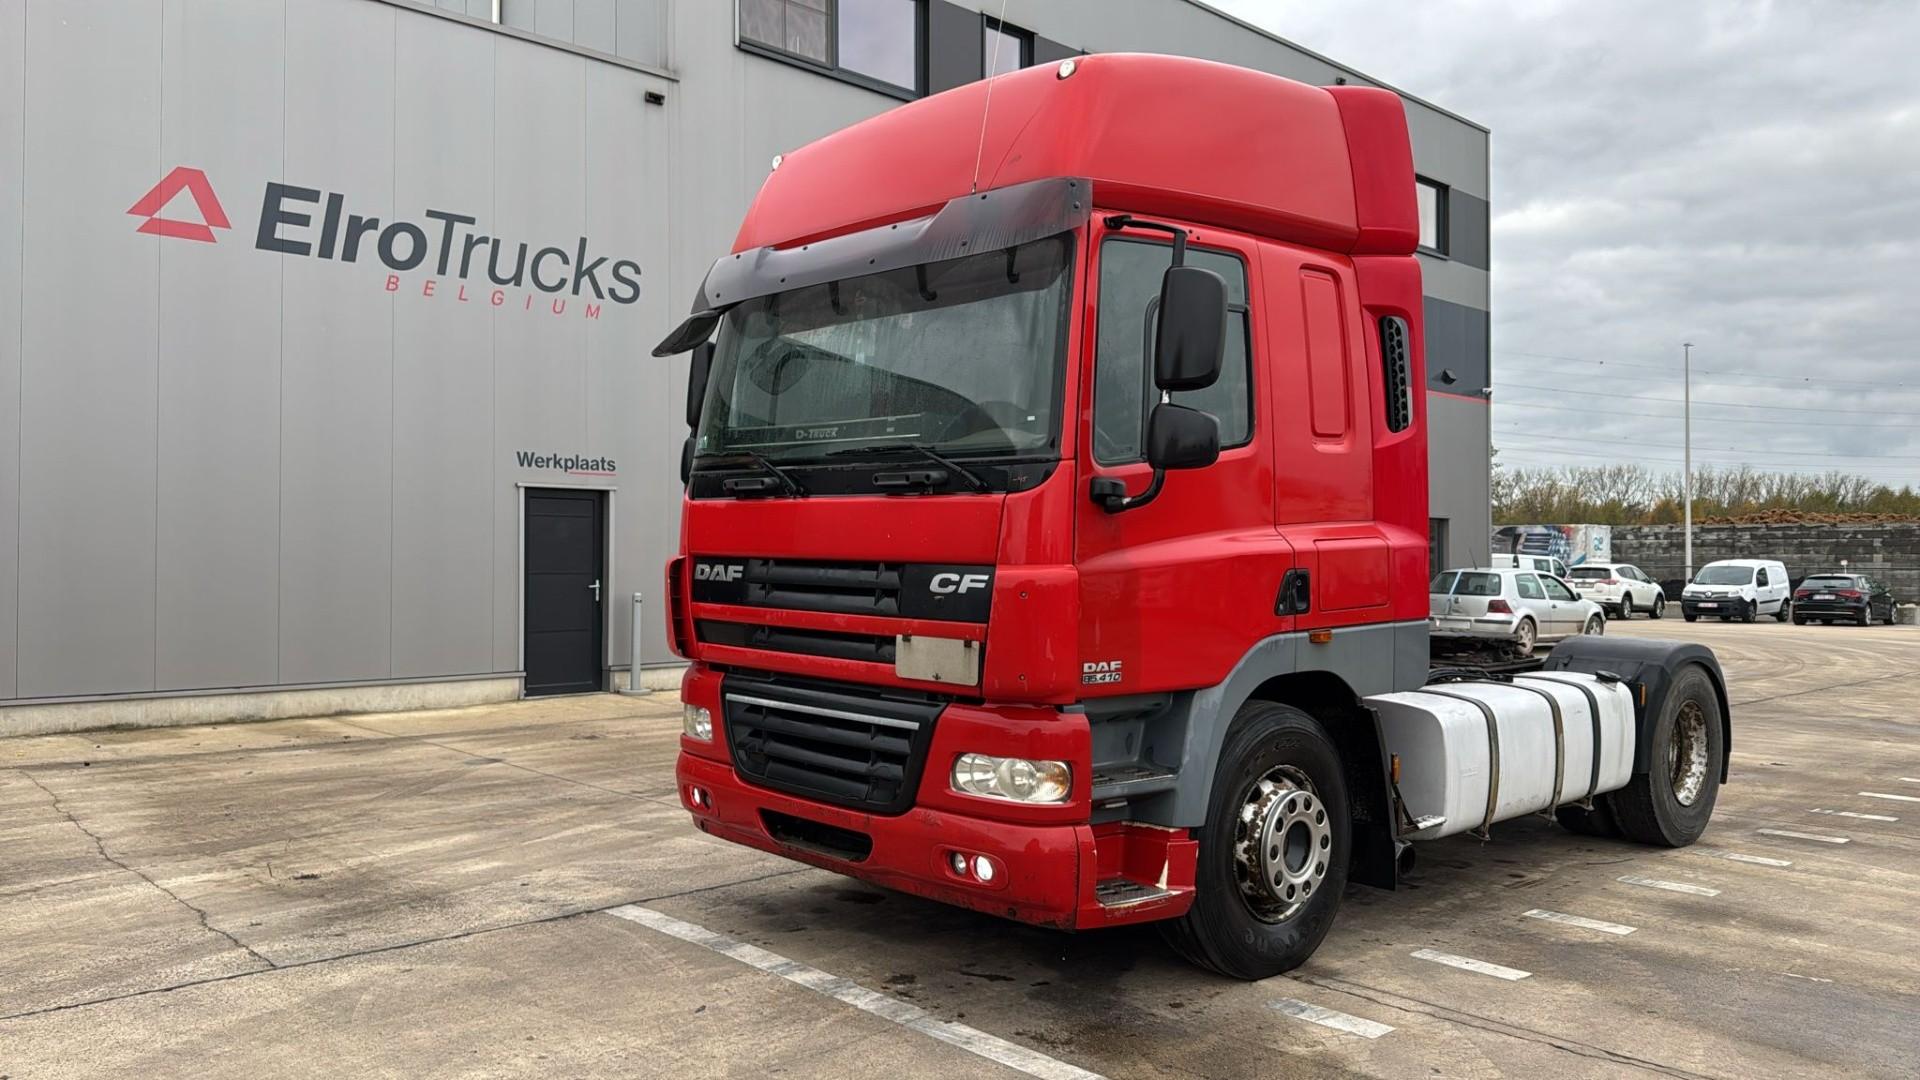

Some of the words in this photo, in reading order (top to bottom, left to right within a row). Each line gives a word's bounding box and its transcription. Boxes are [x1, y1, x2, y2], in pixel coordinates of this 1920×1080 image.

[255, 182, 642, 305] ElroTrucks
[385, 275, 601, 319] BELGIUM
[516, 451, 616, 472] Werkplaats
[694, 564, 743, 582] DAF
[929, 573, 990, 594] CF
[1083, 661, 1122, 673] DAF
